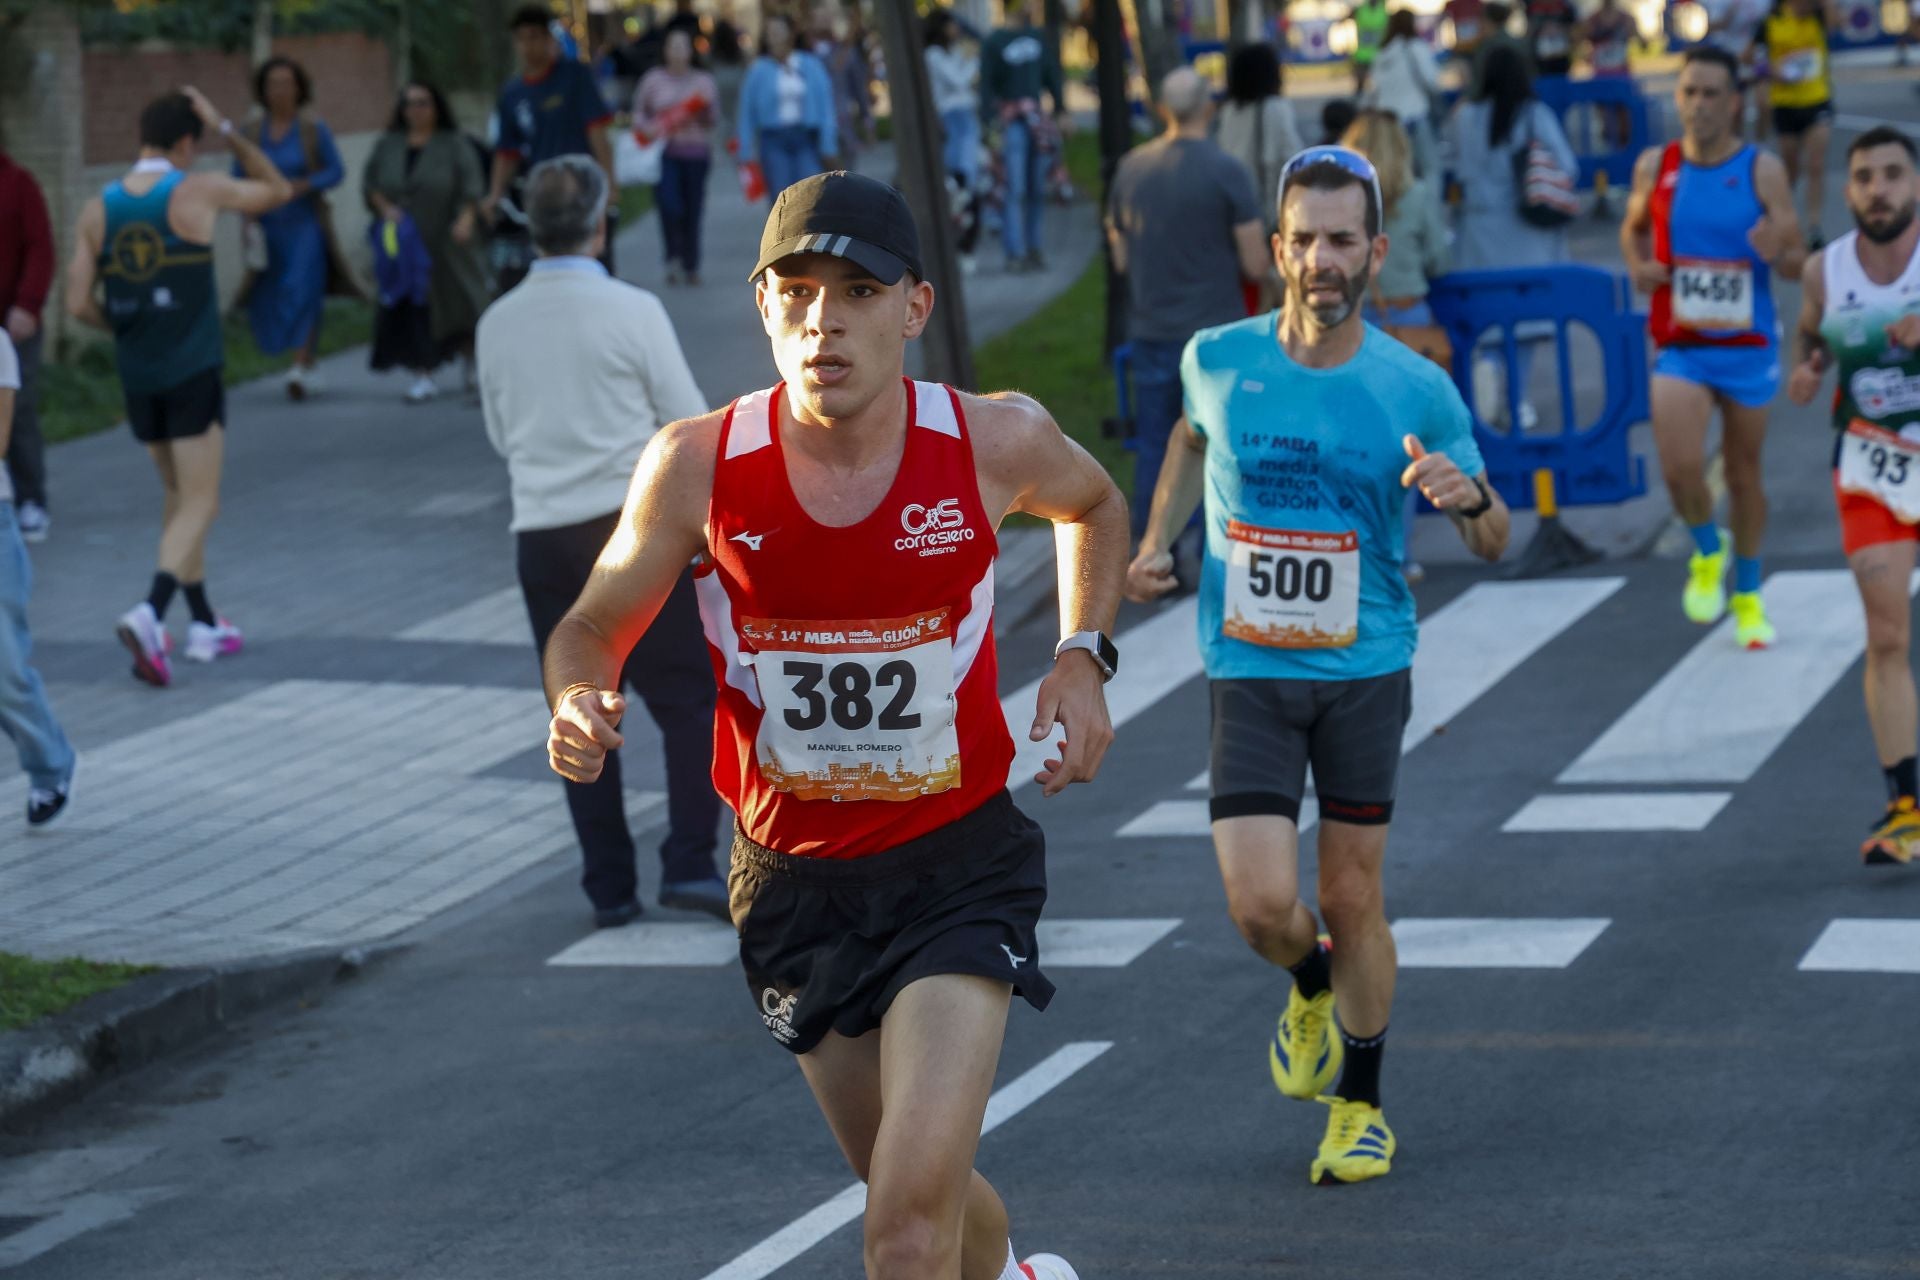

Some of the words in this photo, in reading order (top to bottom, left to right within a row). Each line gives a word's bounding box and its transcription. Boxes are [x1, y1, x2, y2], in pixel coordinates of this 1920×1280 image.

[1272, 435, 1318, 453] MBA
[894, 528, 975, 551] corresiero
[1249, 552, 1332, 602] 500
[803, 631, 846, 644] MBA
[882, 626, 921, 643] GIJÓN
[849, 629, 873, 637] media
[783, 660, 921, 731] 382
[807, 743, 854, 752] MANUEL
[856, 743, 902, 752] ROMERO
